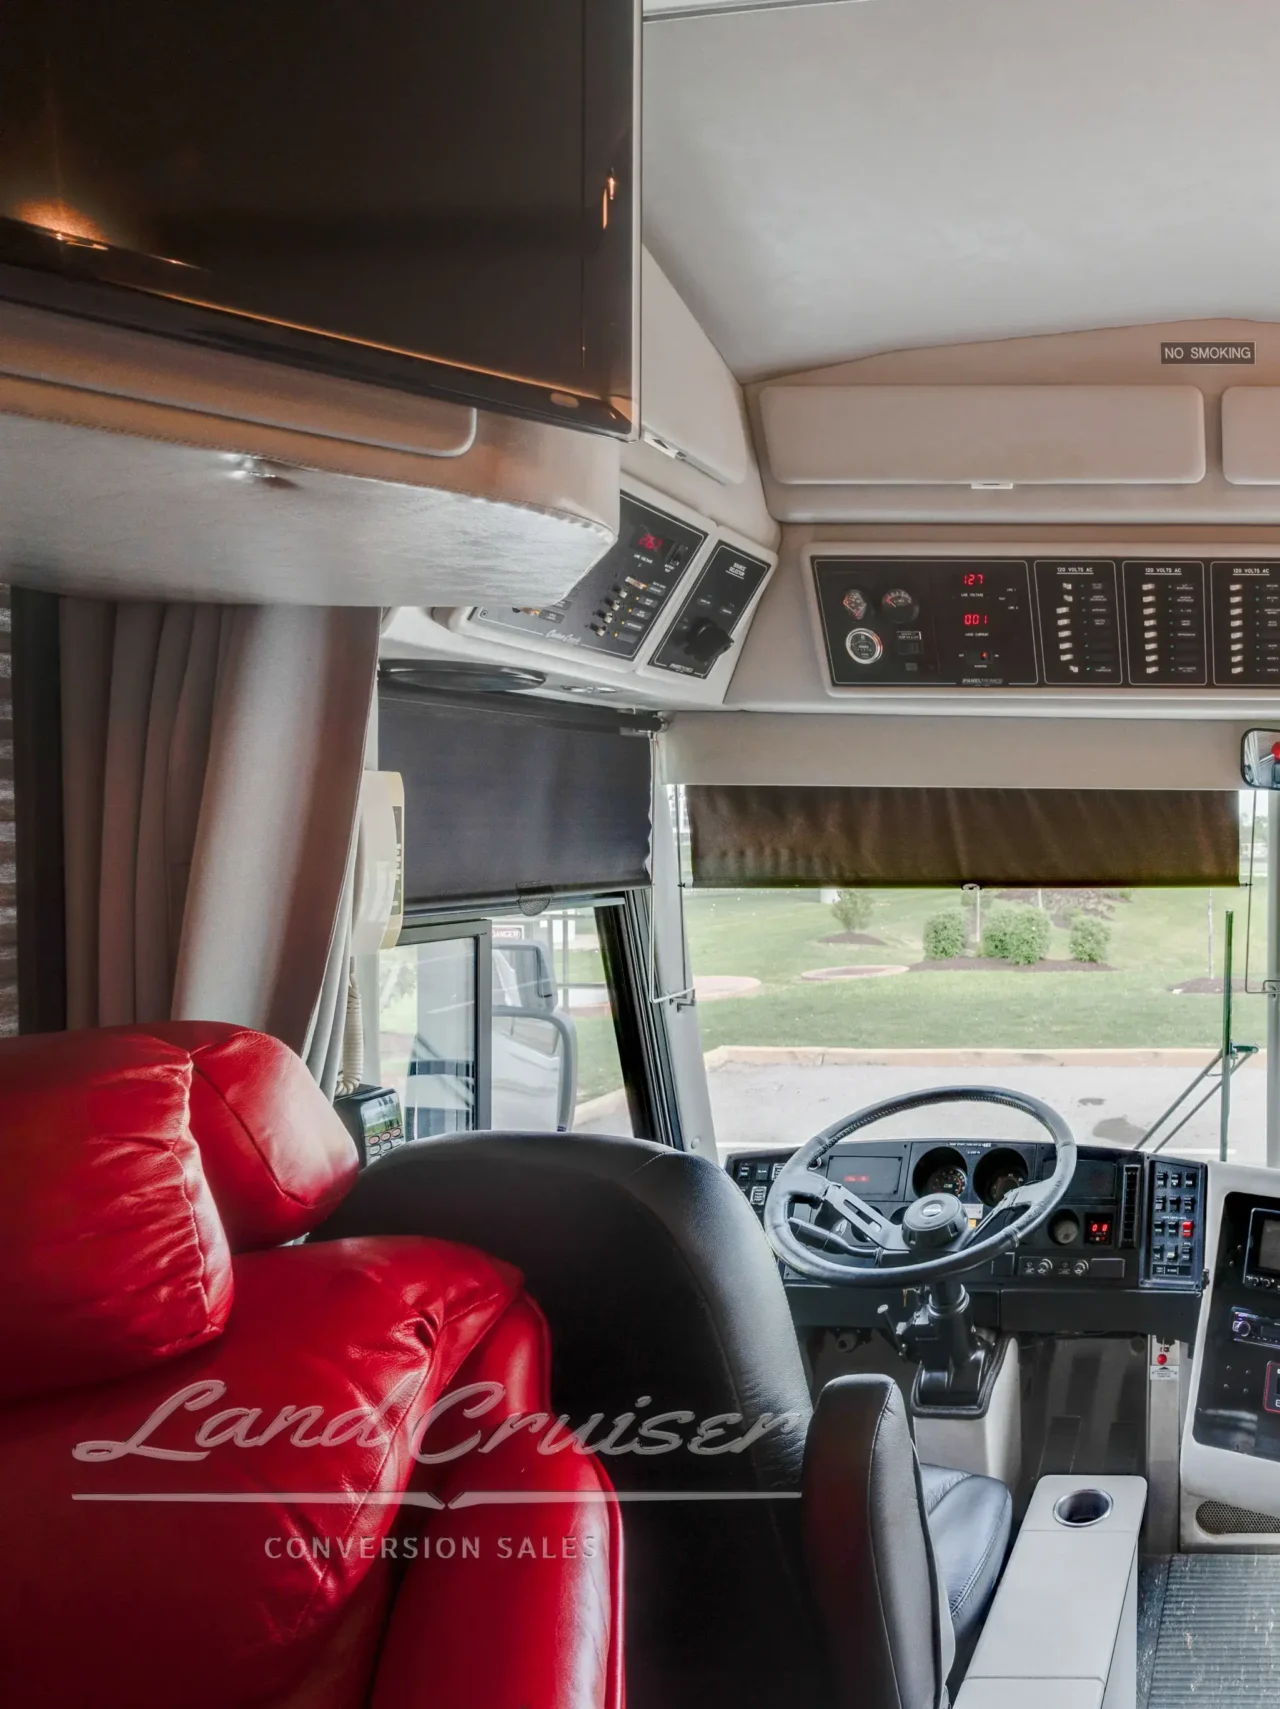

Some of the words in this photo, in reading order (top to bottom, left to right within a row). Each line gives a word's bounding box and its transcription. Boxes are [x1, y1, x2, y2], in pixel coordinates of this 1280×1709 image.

[1164, 347, 1184, 359] NO
[1190, 347, 1251, 359] SMOKING
[963, 574, 984, 585] 127
[964, 614, 988, 625] 001
